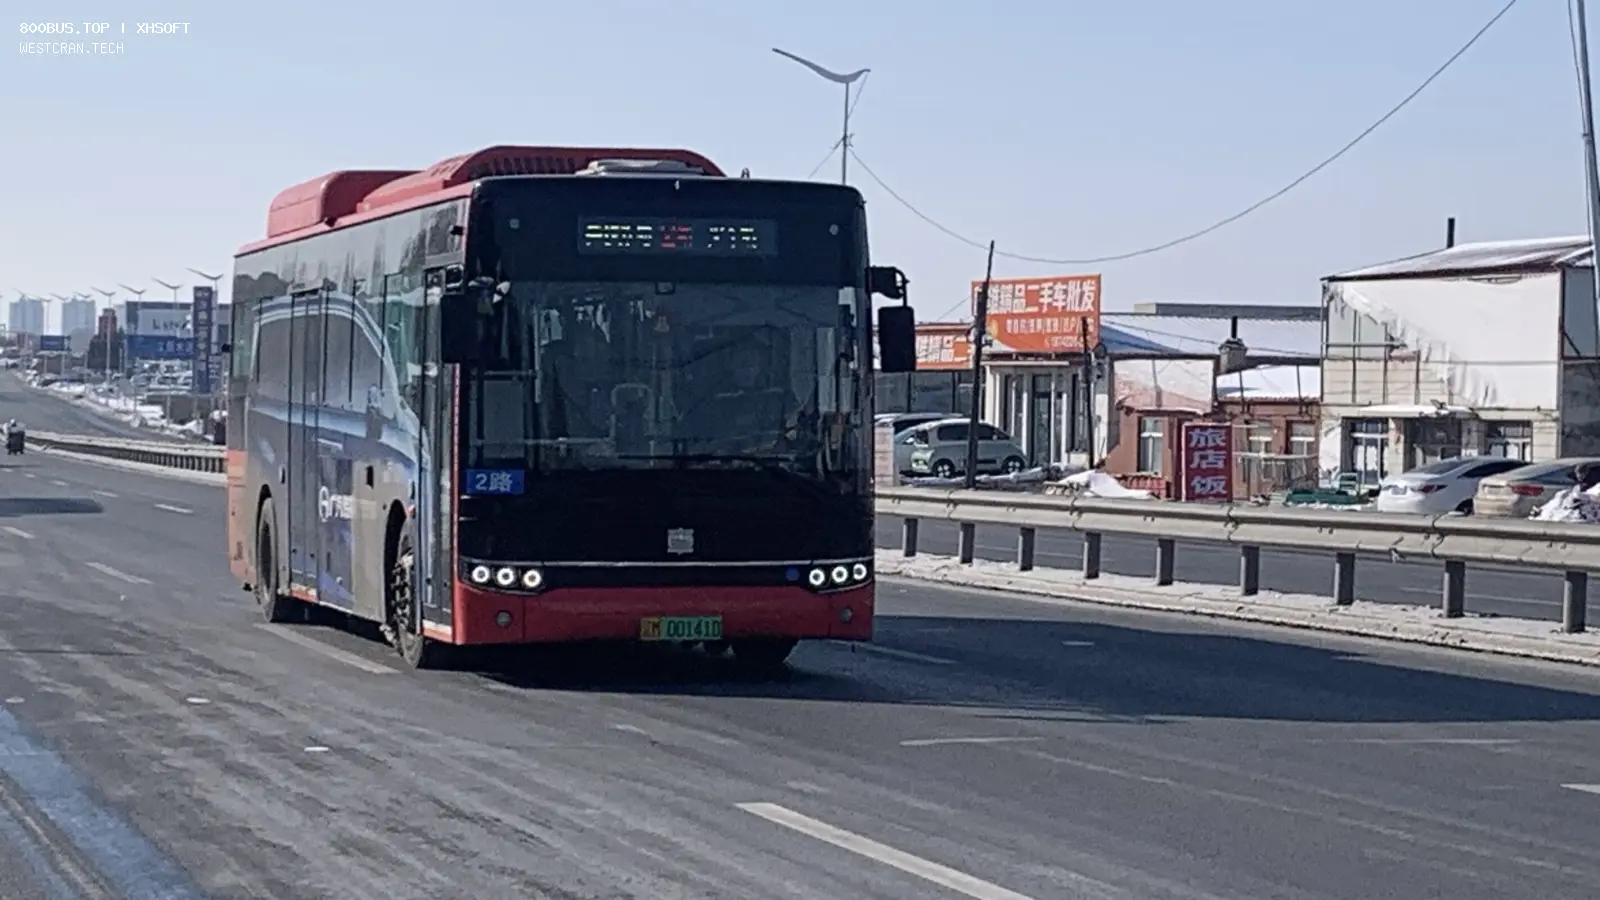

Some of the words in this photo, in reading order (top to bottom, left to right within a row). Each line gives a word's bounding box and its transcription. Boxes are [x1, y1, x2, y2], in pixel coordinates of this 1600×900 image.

[973, 279, 1096, 315] 精品二手车批发
[915, 334, 974, 363] 精品二
[475, 471, 513, 492] 2路
[1188, 428, 1228, 503] 旅店饭
